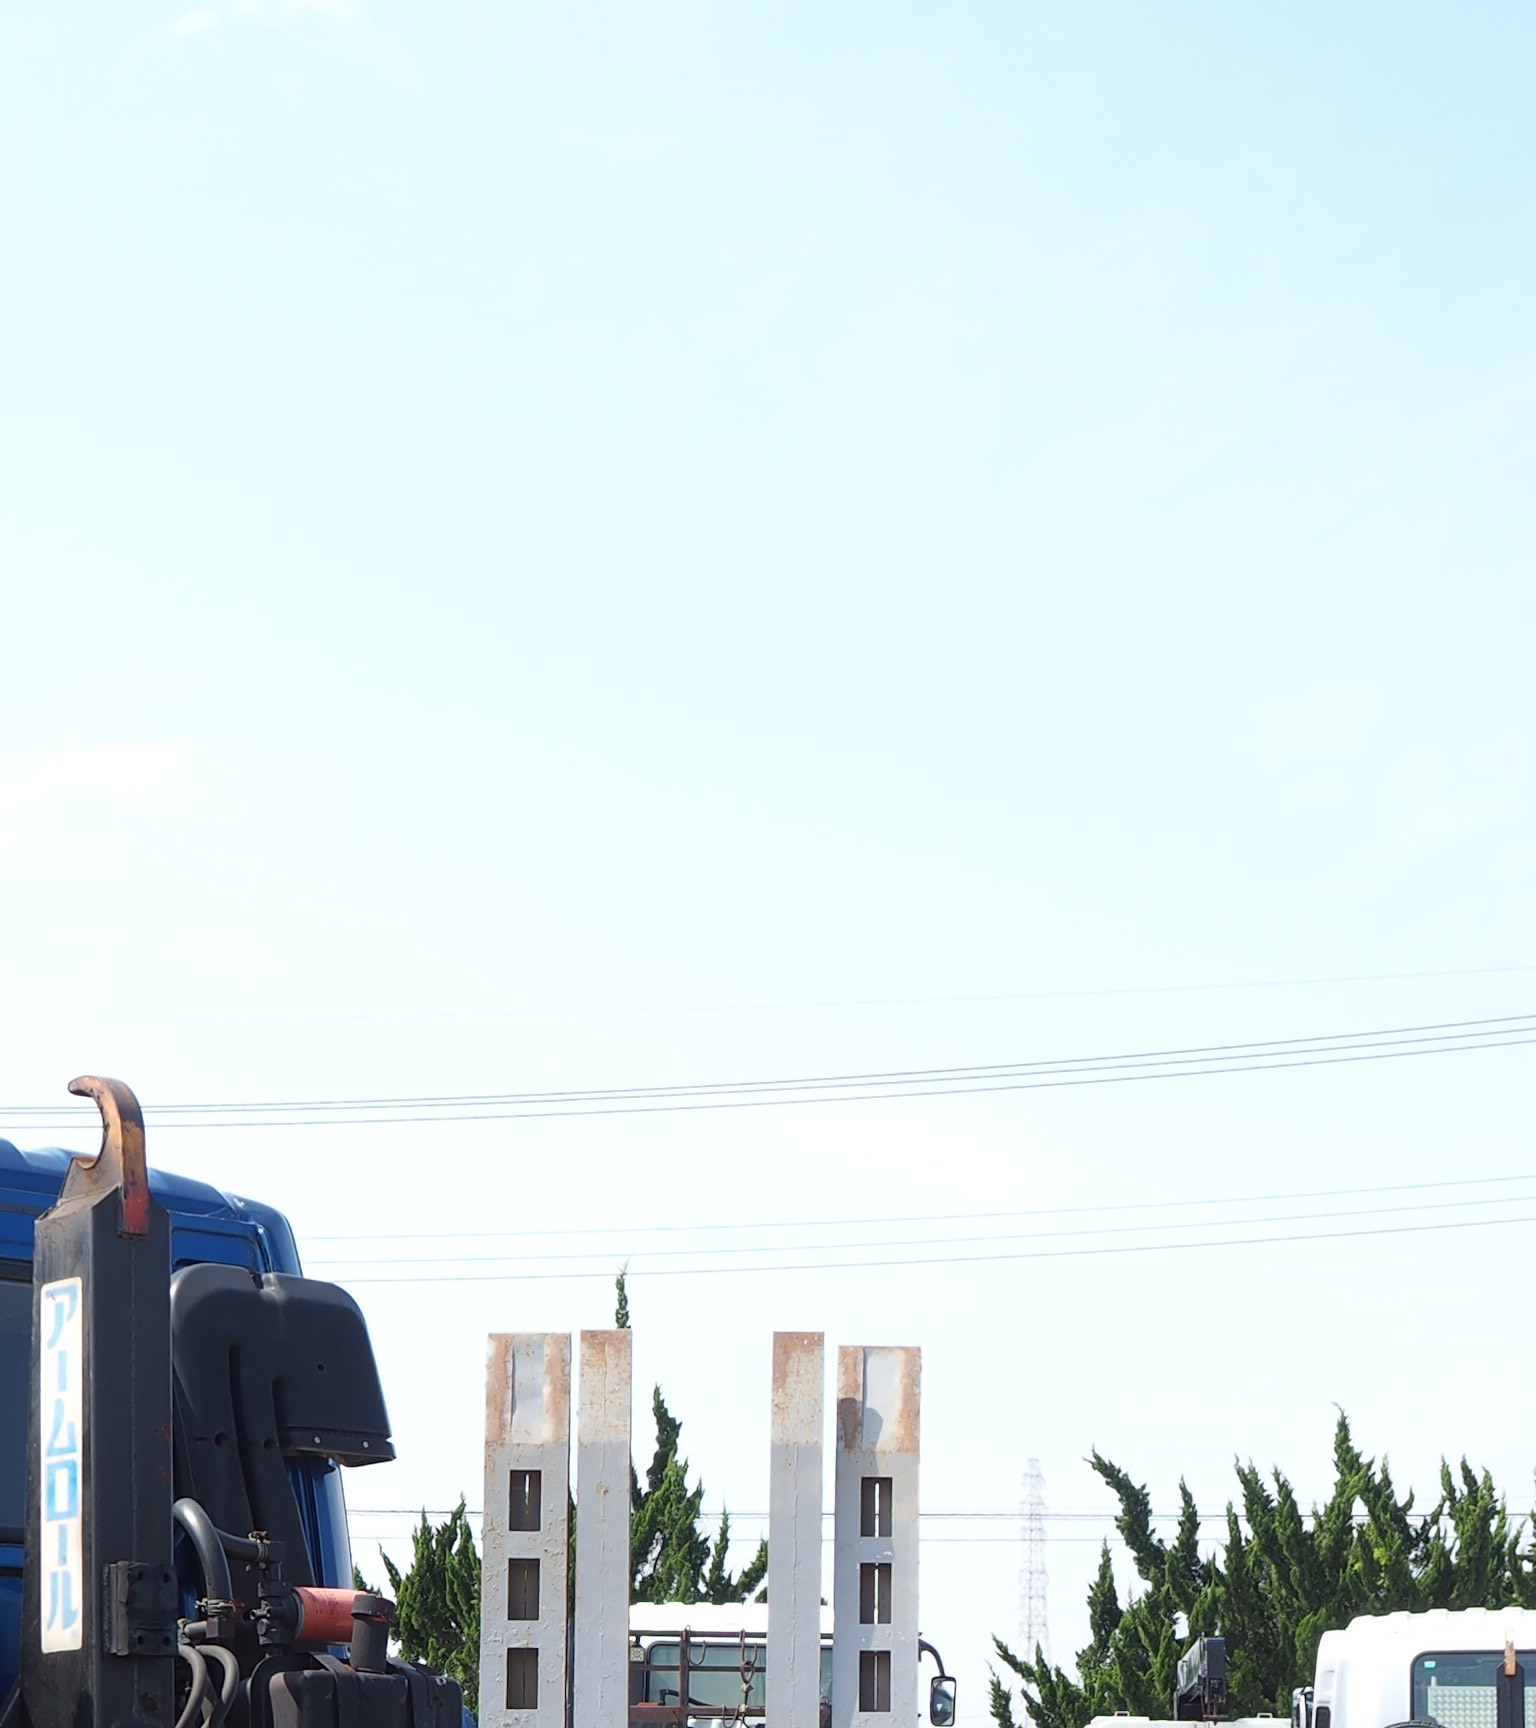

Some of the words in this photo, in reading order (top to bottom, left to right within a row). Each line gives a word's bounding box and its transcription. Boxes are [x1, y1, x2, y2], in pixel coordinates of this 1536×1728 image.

[46, 1284, 79, 1631] アームロール
